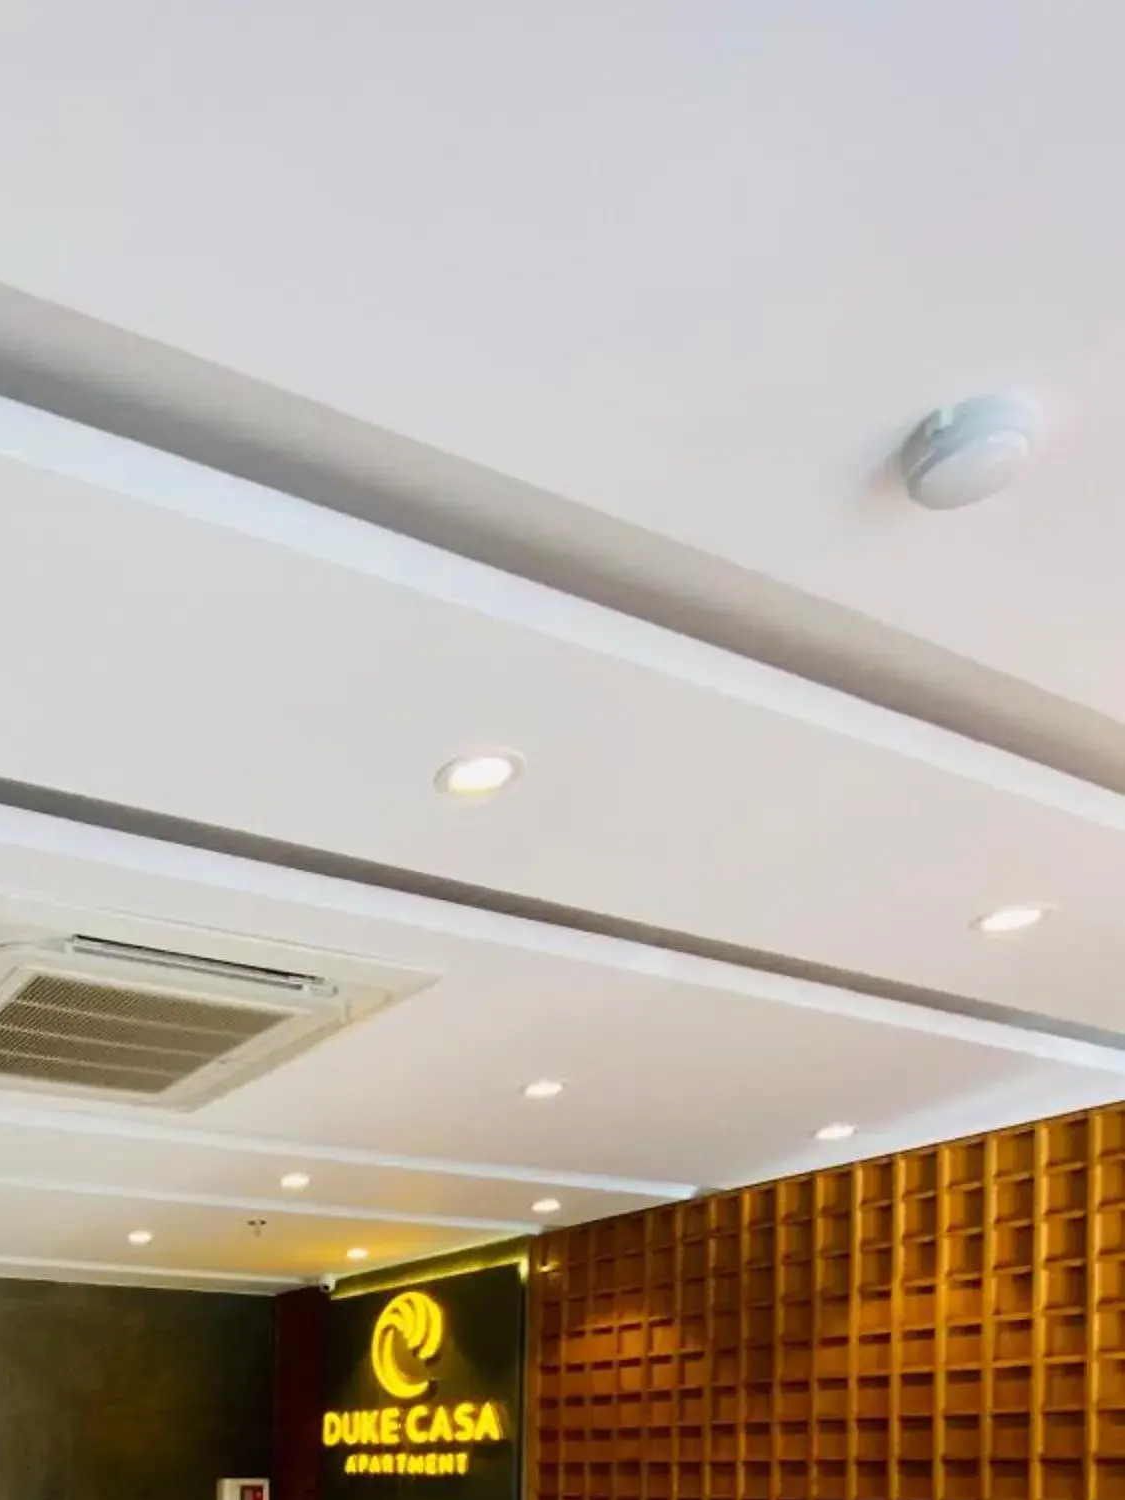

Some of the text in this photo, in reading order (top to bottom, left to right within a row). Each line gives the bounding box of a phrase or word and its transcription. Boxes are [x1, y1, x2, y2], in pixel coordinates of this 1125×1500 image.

[323, 1402, 501, 1446] DUKE CASA
[344, 1452, 468, 1475] APARTMENT
